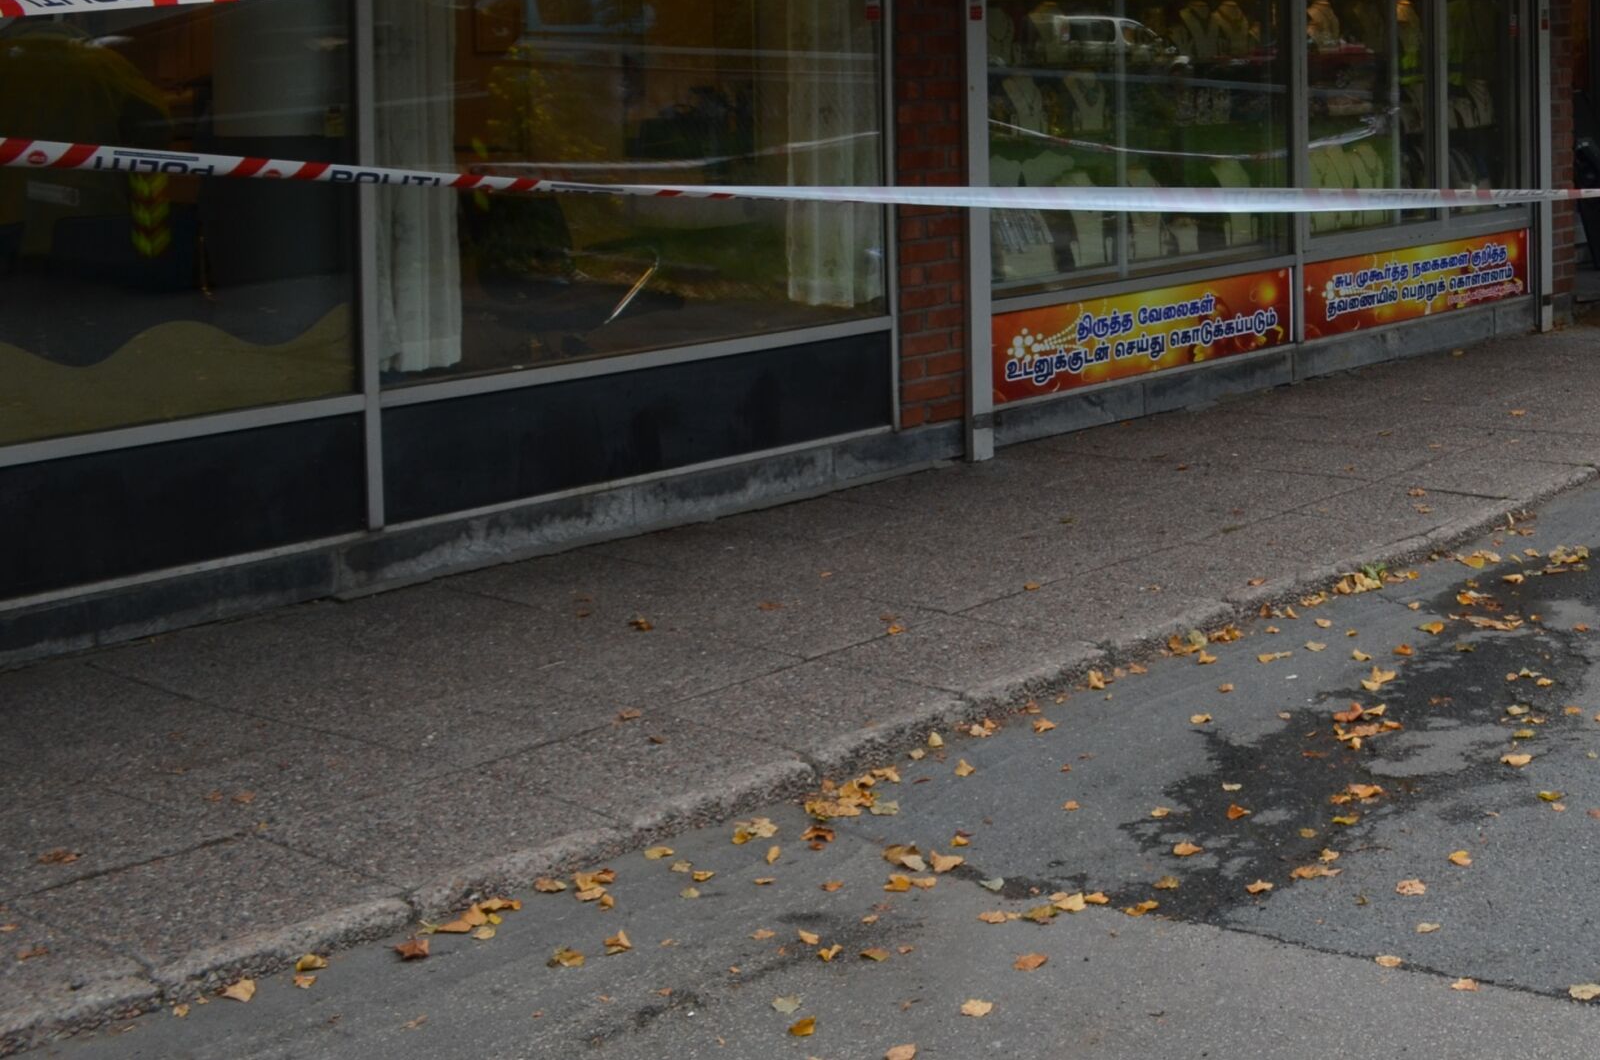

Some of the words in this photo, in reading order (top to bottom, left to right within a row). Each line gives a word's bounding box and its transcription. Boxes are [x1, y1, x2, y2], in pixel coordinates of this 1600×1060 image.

[1333, 272, 1353, 289] சுப
[1412, 252, 1469, 278] நகைகளை
[1470, 243, 1508, 268] குறித்த
[1077, 310, 1133, 340] திருத்த
[1137, 294, 1215, 326] வேலைகள்
[1327, 286, 1399, 319] தவணையில்
[1006, 341, 1112, 383] உடனுக்குடன்
[1114, 331, 1166, 359] செய்து
